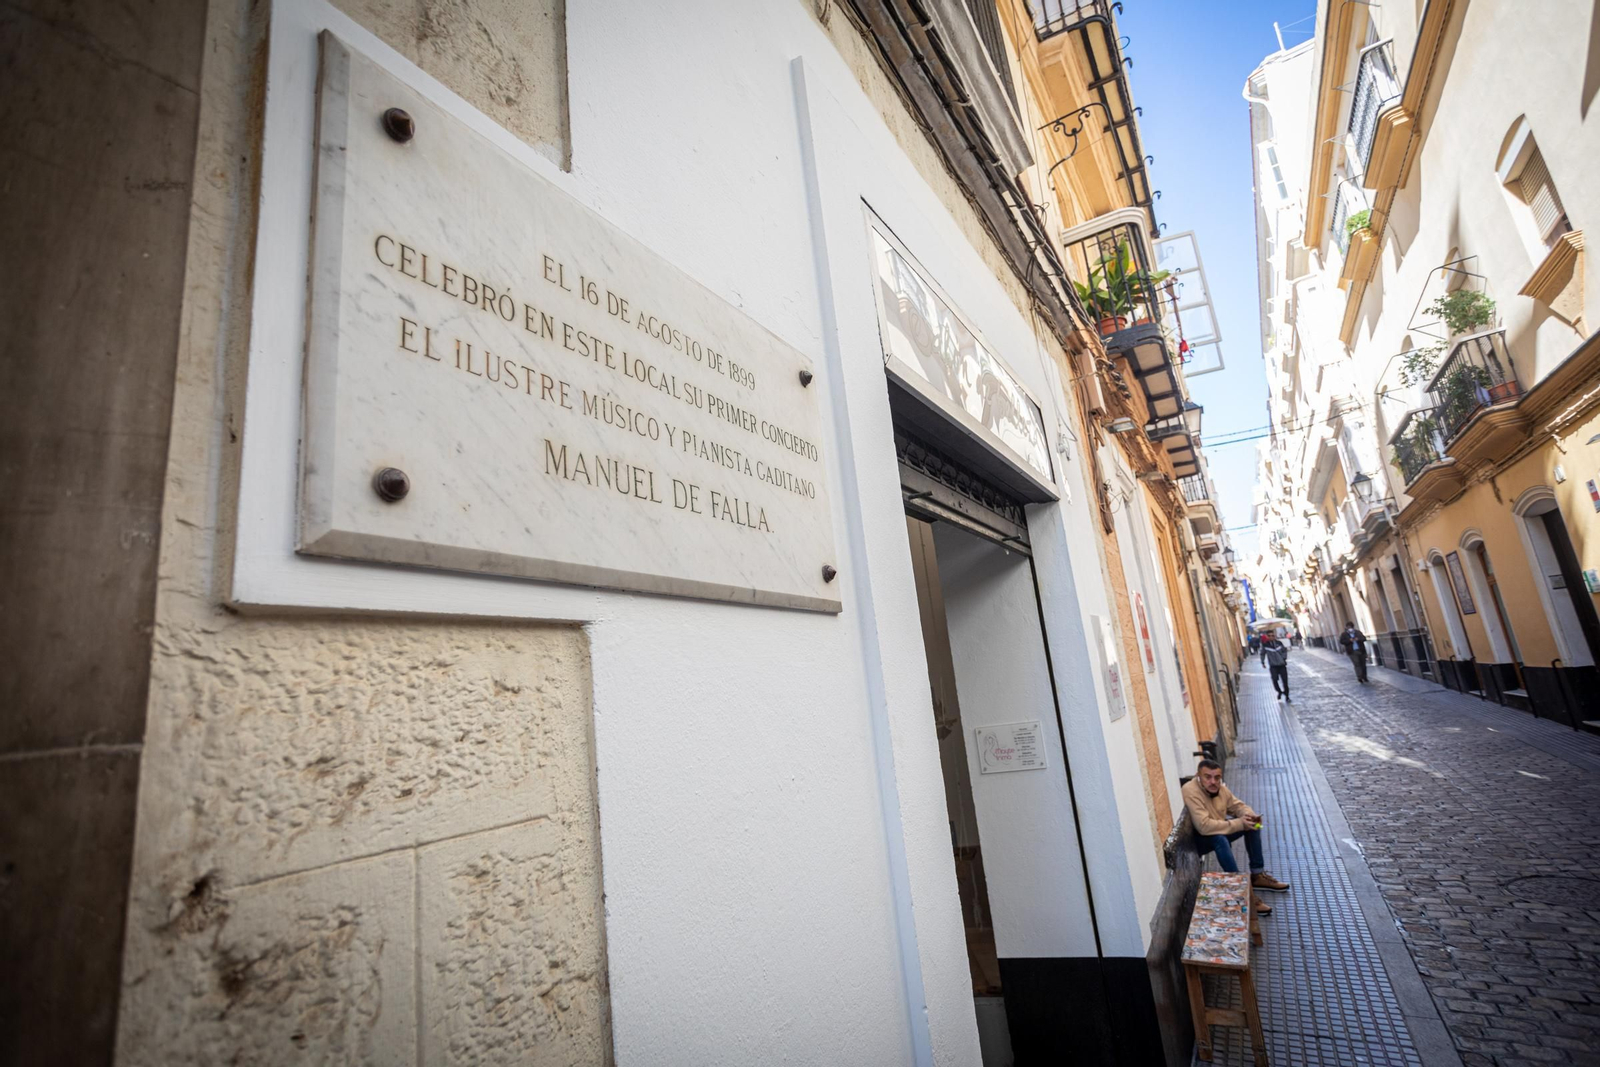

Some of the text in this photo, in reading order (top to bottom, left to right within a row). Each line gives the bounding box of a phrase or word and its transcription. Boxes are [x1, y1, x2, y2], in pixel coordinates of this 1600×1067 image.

[374, 234, 818, 462] CELEBRÓ EN ESTE LOCAL SU PRIMER CONCIERTO
[542, 254, 756, 390] EL 16 DE AGOSTO DE 1899
[400, 316, 816, 500] EL ILUSTRE MÚSICO Y PIANISTA GADITANO
[543, 438, 775, 534] MANUEL DE FALLA.
